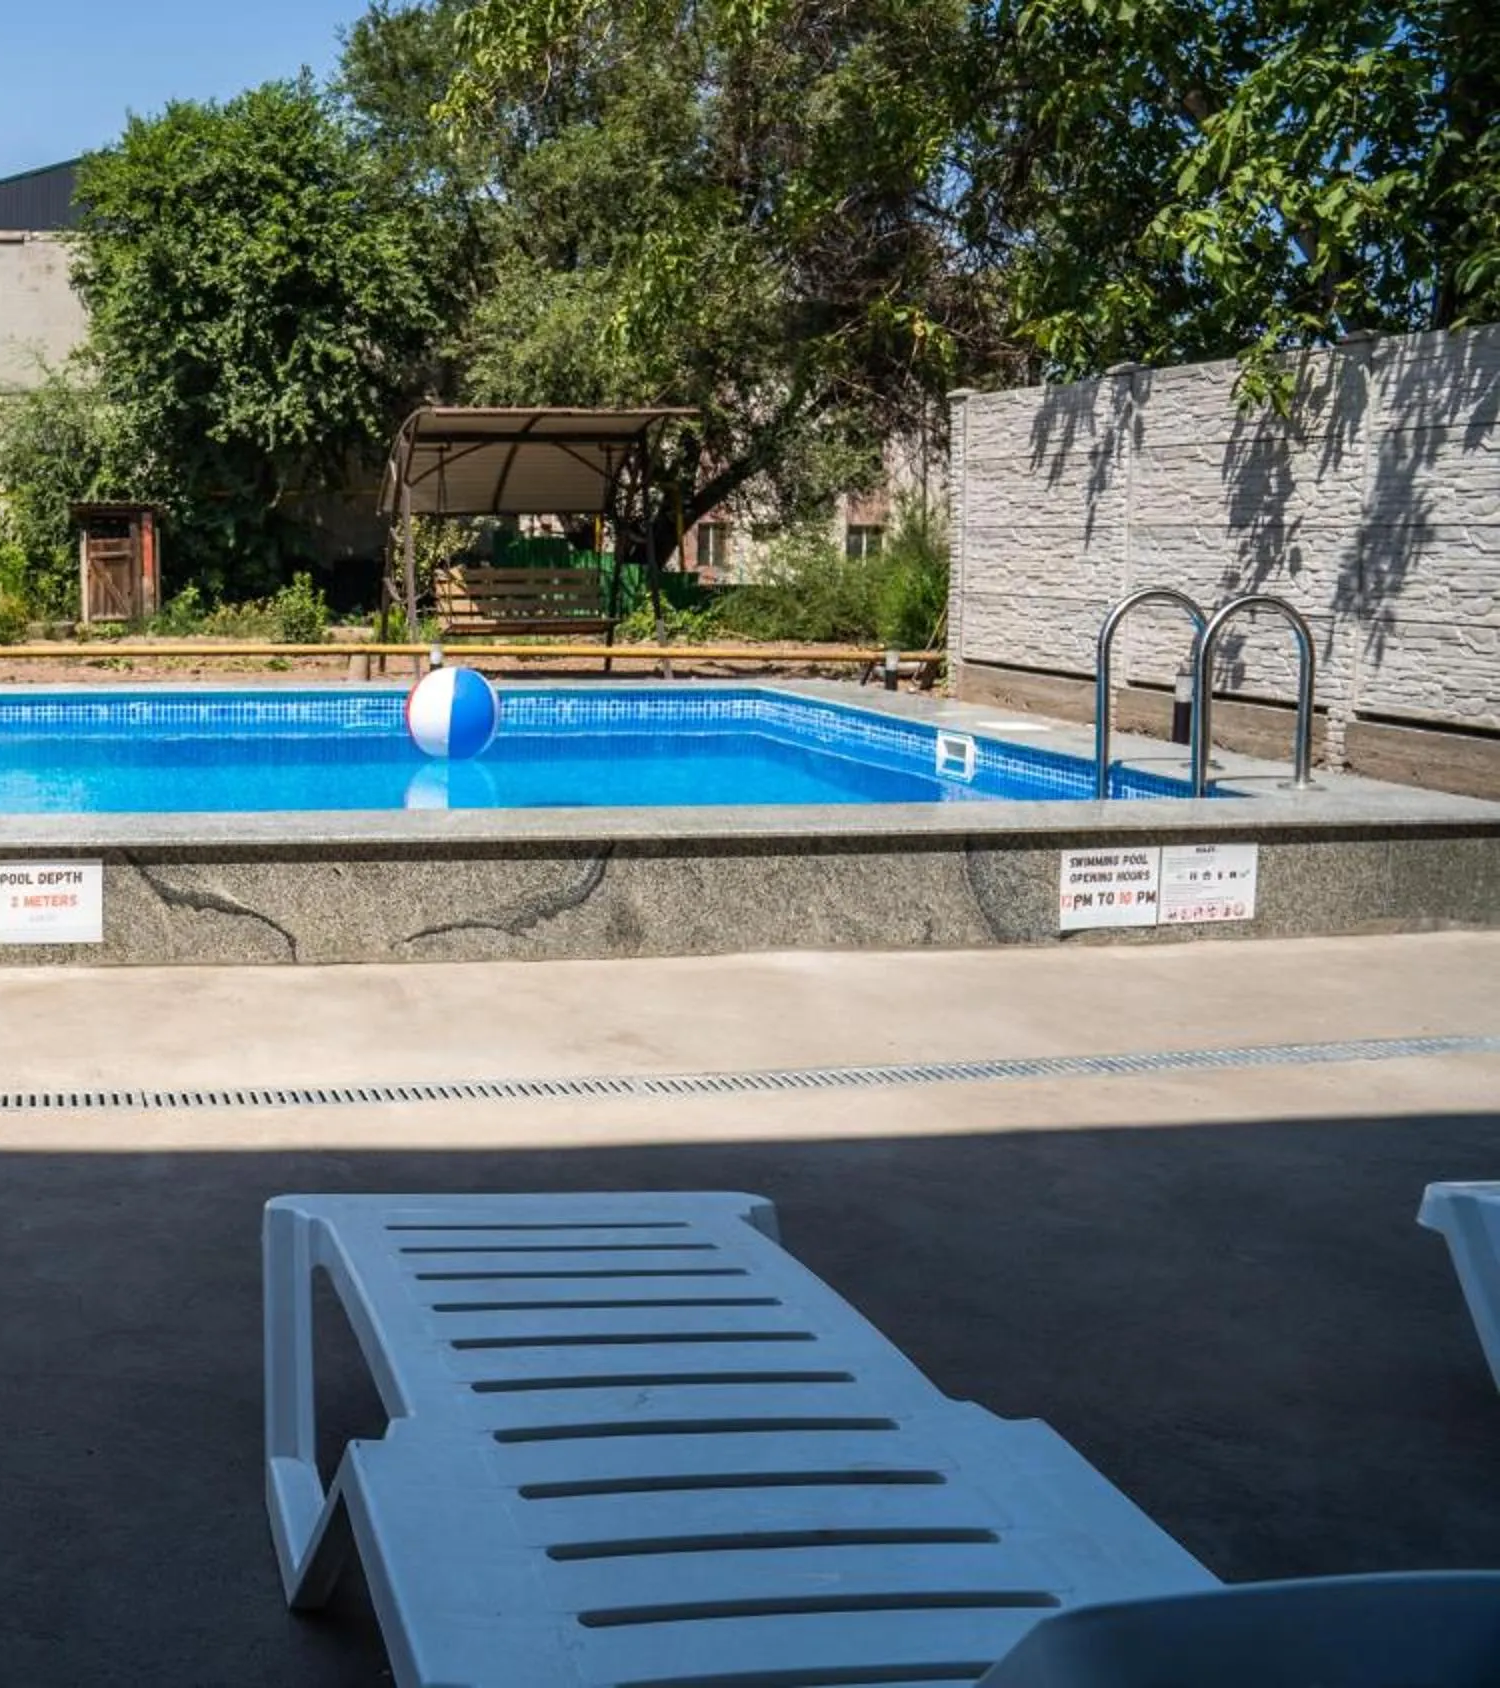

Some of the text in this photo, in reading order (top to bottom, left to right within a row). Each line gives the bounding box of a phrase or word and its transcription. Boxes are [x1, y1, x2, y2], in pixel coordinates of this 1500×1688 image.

[1123, 853, 1149, 865] POOL
[0, 871, 83, 885] POOL DEPTH
[23, 894, 77, 908] METERS
[1097, 891, 1115, 906] TO
[1136, 890, 1157, 904] PM
